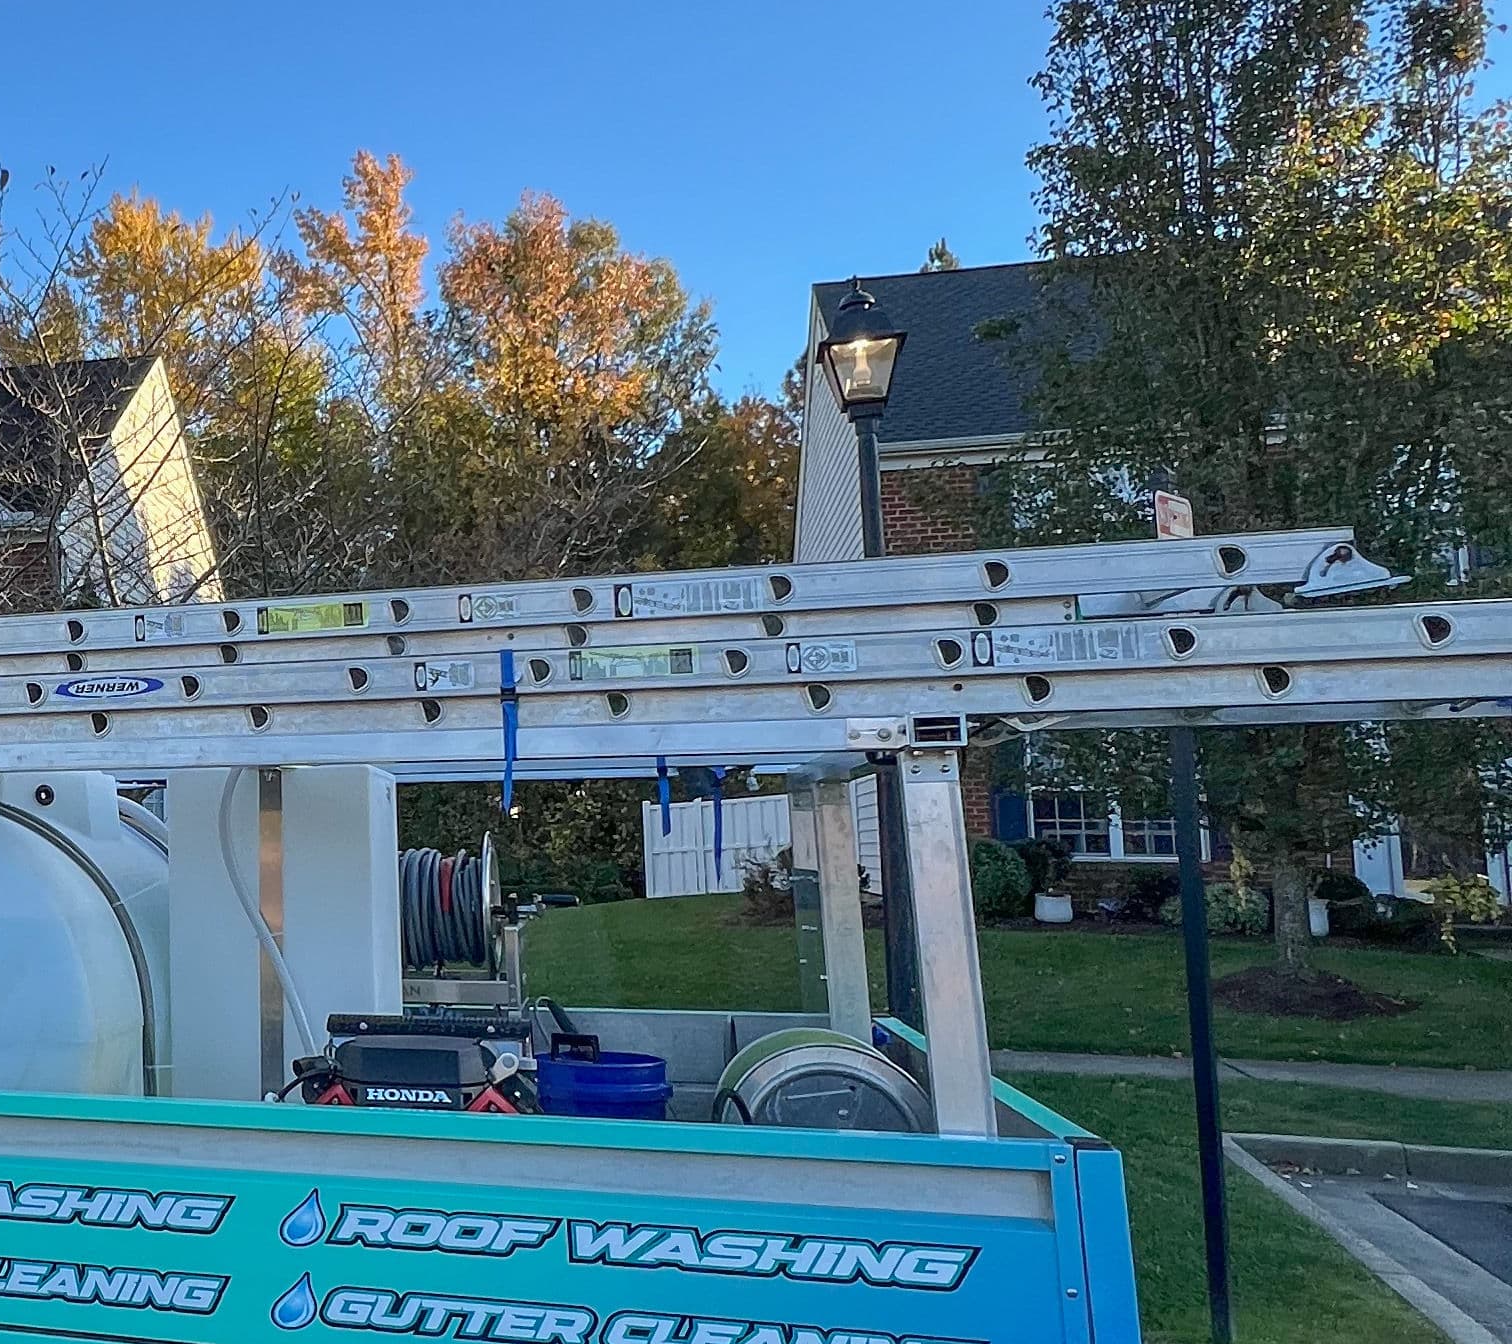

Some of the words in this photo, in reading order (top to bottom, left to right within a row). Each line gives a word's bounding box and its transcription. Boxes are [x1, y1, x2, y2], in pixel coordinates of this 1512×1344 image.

[74, 679, 140, 694] WERNER
[366, 1088, 452, 1104] HONDA
[329, 1205, 561, 1254] ROOF
[568, 1220, 981, 1290] WASHING
